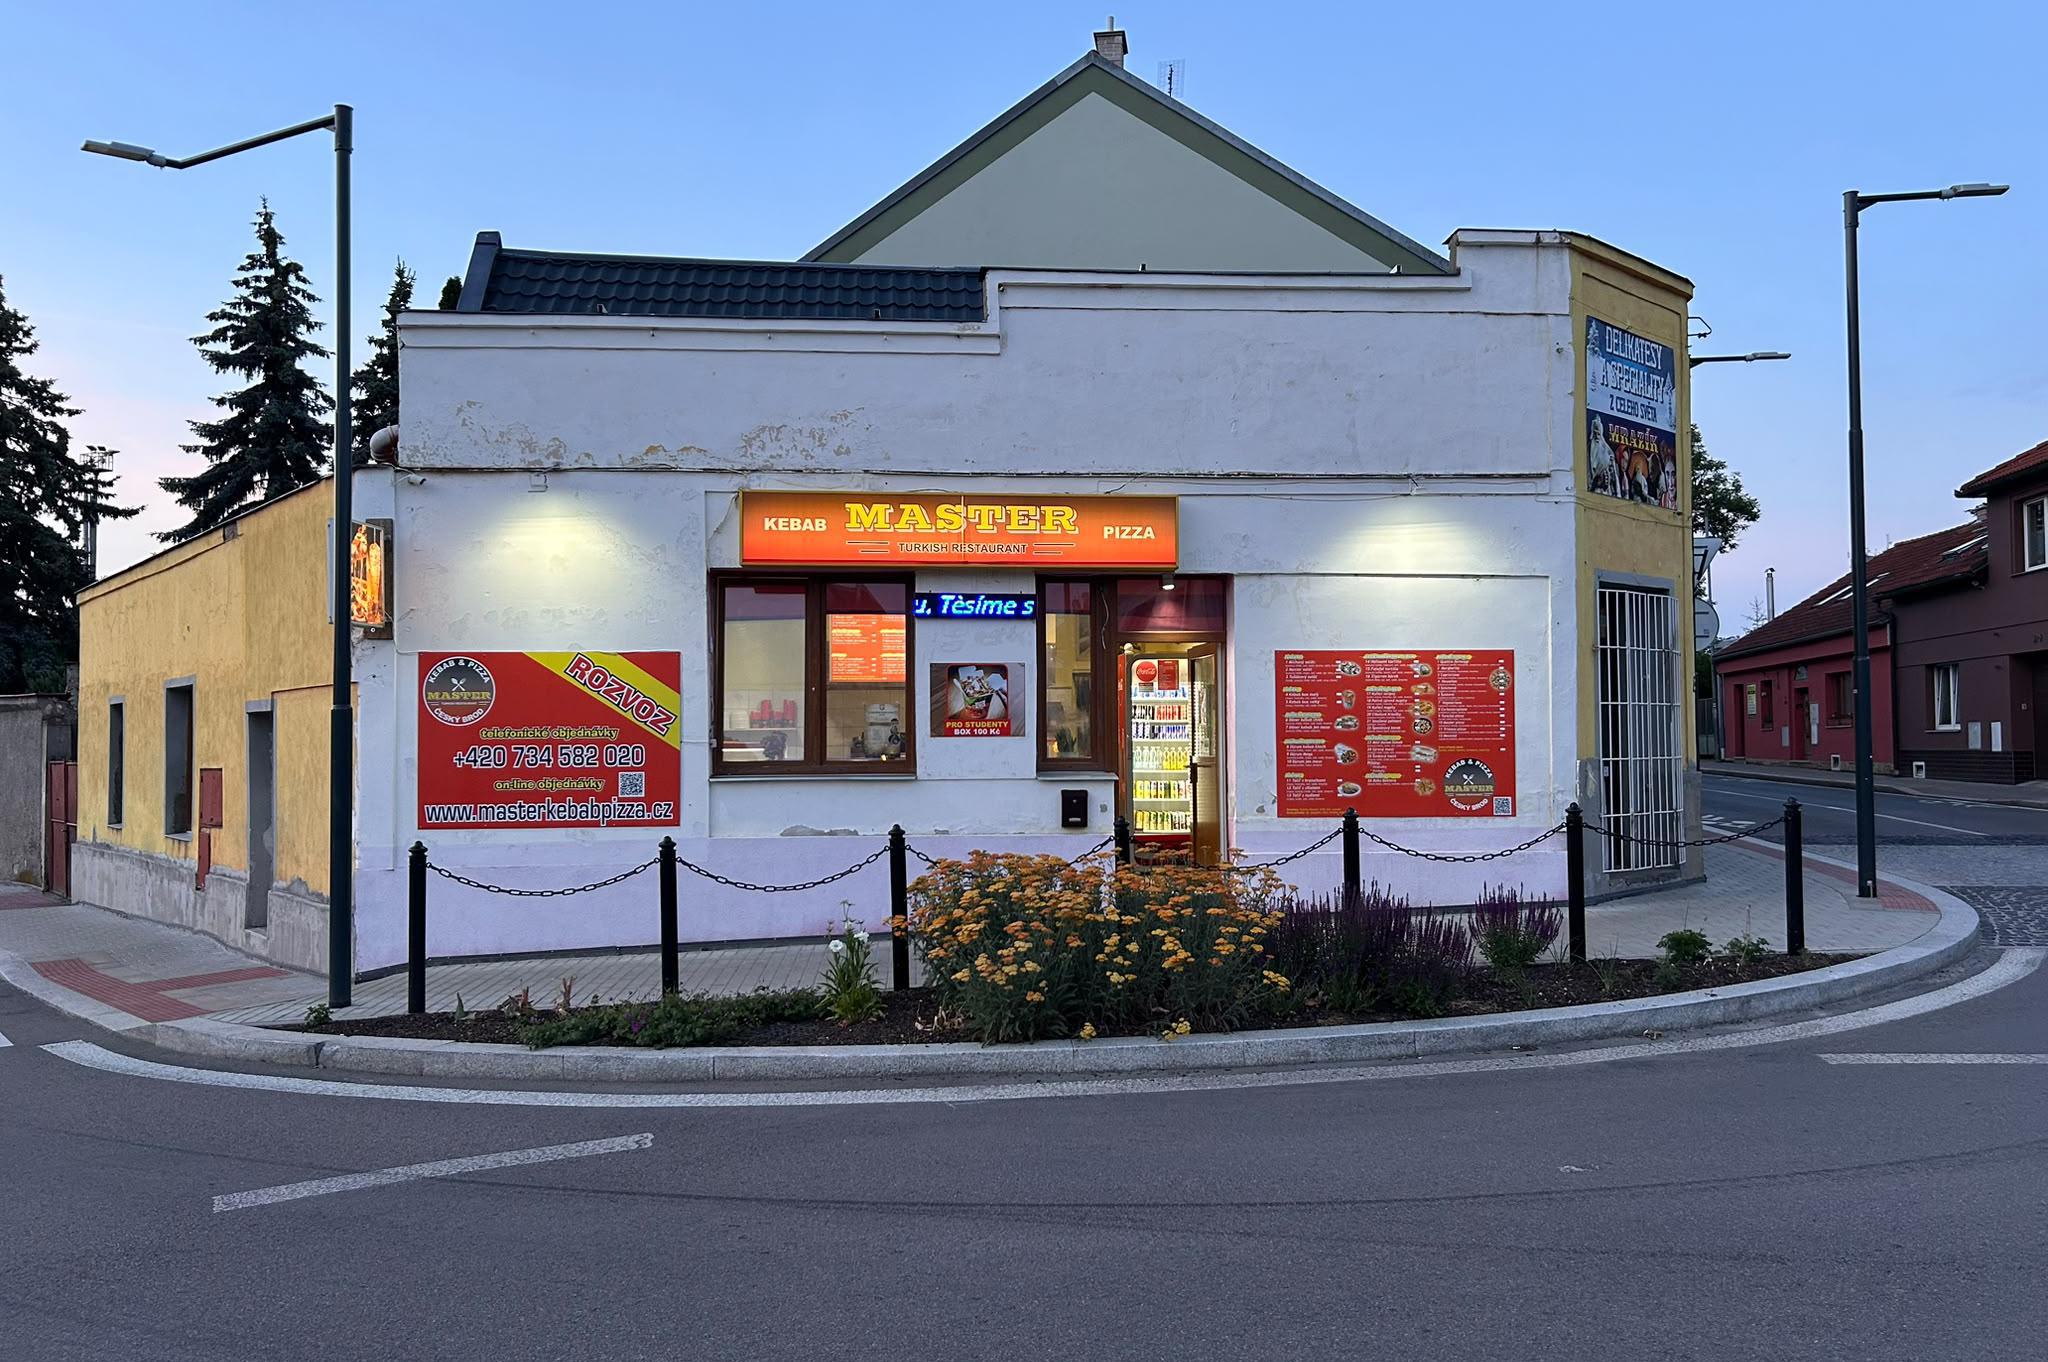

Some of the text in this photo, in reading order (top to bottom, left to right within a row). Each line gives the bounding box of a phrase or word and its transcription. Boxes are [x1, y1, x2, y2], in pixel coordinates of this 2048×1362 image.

[1605, 326, 1662, 370] DELIKATESY
[1610, 359, 1665, 404] SPECIALITY
[1609, 394, 1614, 411] Z
[764, 517, 827, 532] KEBAB
[845, 503, 1079, 534] MASTER
[1103, 525, 1156, 540] PIZZA
[898, 543, 1028, 554] TURKISH RESTAURANT
[1021, 600, 1035, 615] s
[428, 659, 456, 683] KEBAB
[467, 661, 490, 683] PIZZA
[427, 691, 492, 701] MASTER
[565, 653, 677, 735] ROZVOZ
[462, 708, 484, 723] BROD
[480, 726, 619, 742] telefonické objednávky
[454, 744, 645, 768] +420 734 582 020
[1445, 759, 1466, 779] KEBAB
[1475, 760, 1493, 778] PIZZA
[494, 777, 605, 793] on-line objednávky
[1444, 785, 1494, 793] MASTER
[425, 798, 673, 826] www.masterkebabpizza.cz
